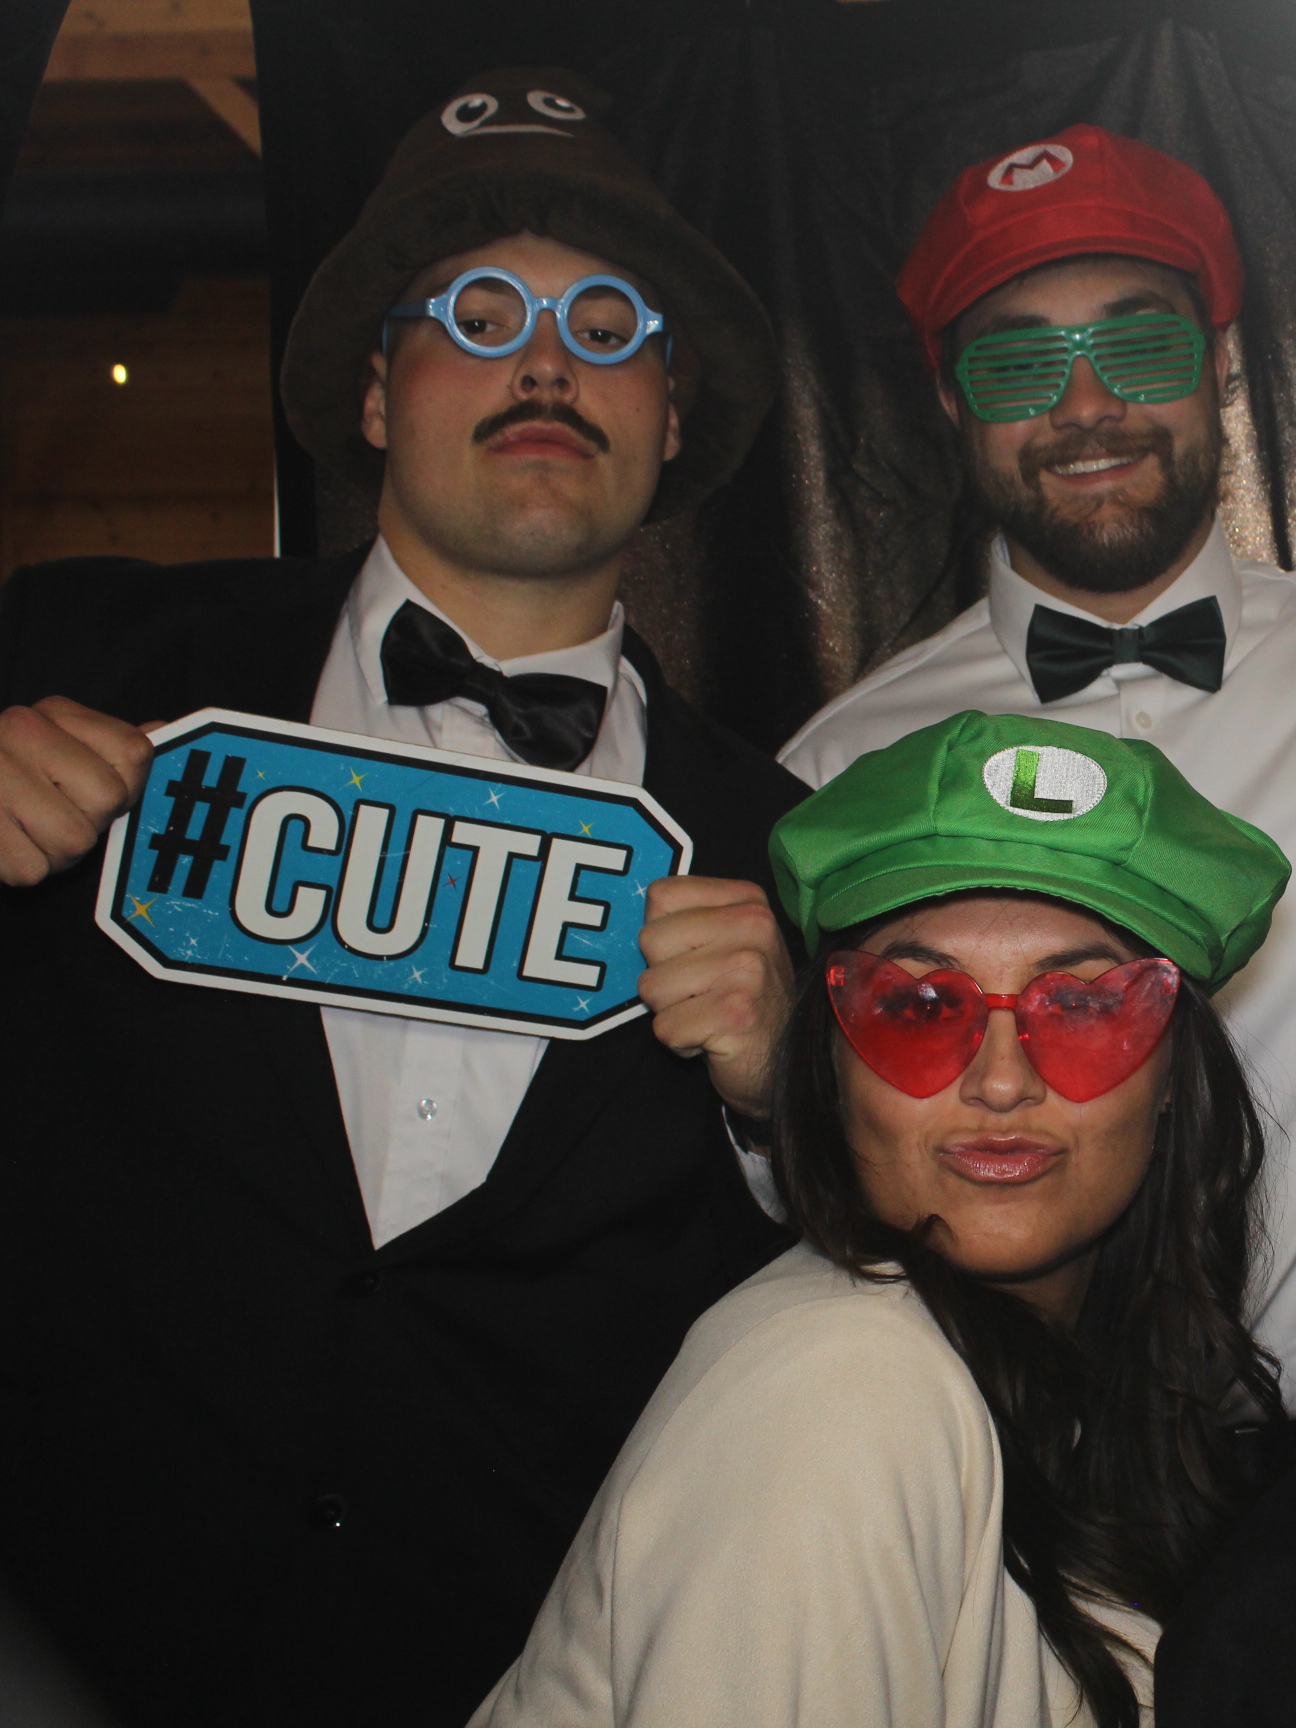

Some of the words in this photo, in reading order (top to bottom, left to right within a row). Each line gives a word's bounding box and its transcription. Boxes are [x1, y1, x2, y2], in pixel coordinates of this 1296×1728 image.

[999, 149, 1066, 186] M
[1010, 749, 1074, 814] L
[146, 748, 634, 992] #CUTE
